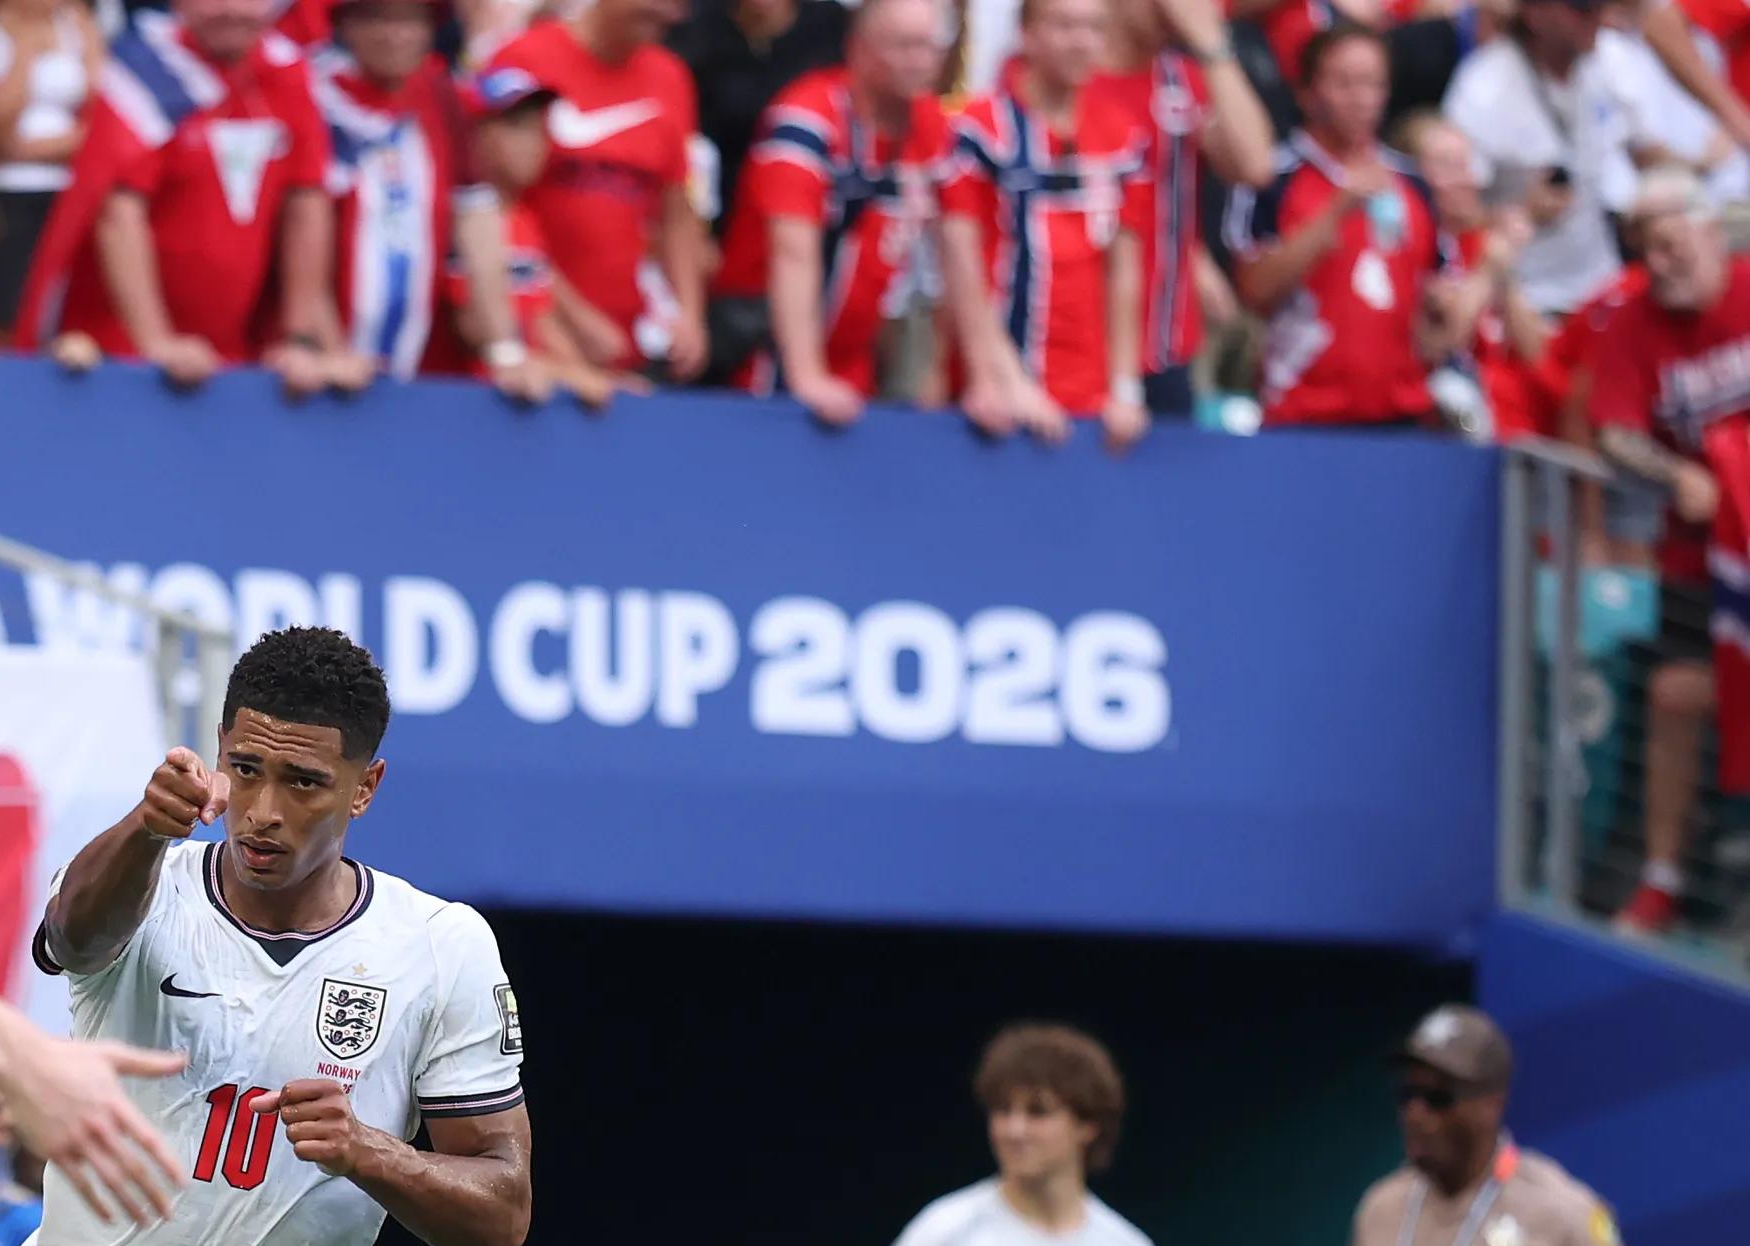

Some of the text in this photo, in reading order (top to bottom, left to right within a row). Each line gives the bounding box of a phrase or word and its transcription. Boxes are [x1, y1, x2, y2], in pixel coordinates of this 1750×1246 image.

[486, 580, 740, 729] CUP
[748, 595, 1174, 753] 2026
[316, 1062, 361, 1081] NORWAY
[192, 1083, 279, 1191] 10
